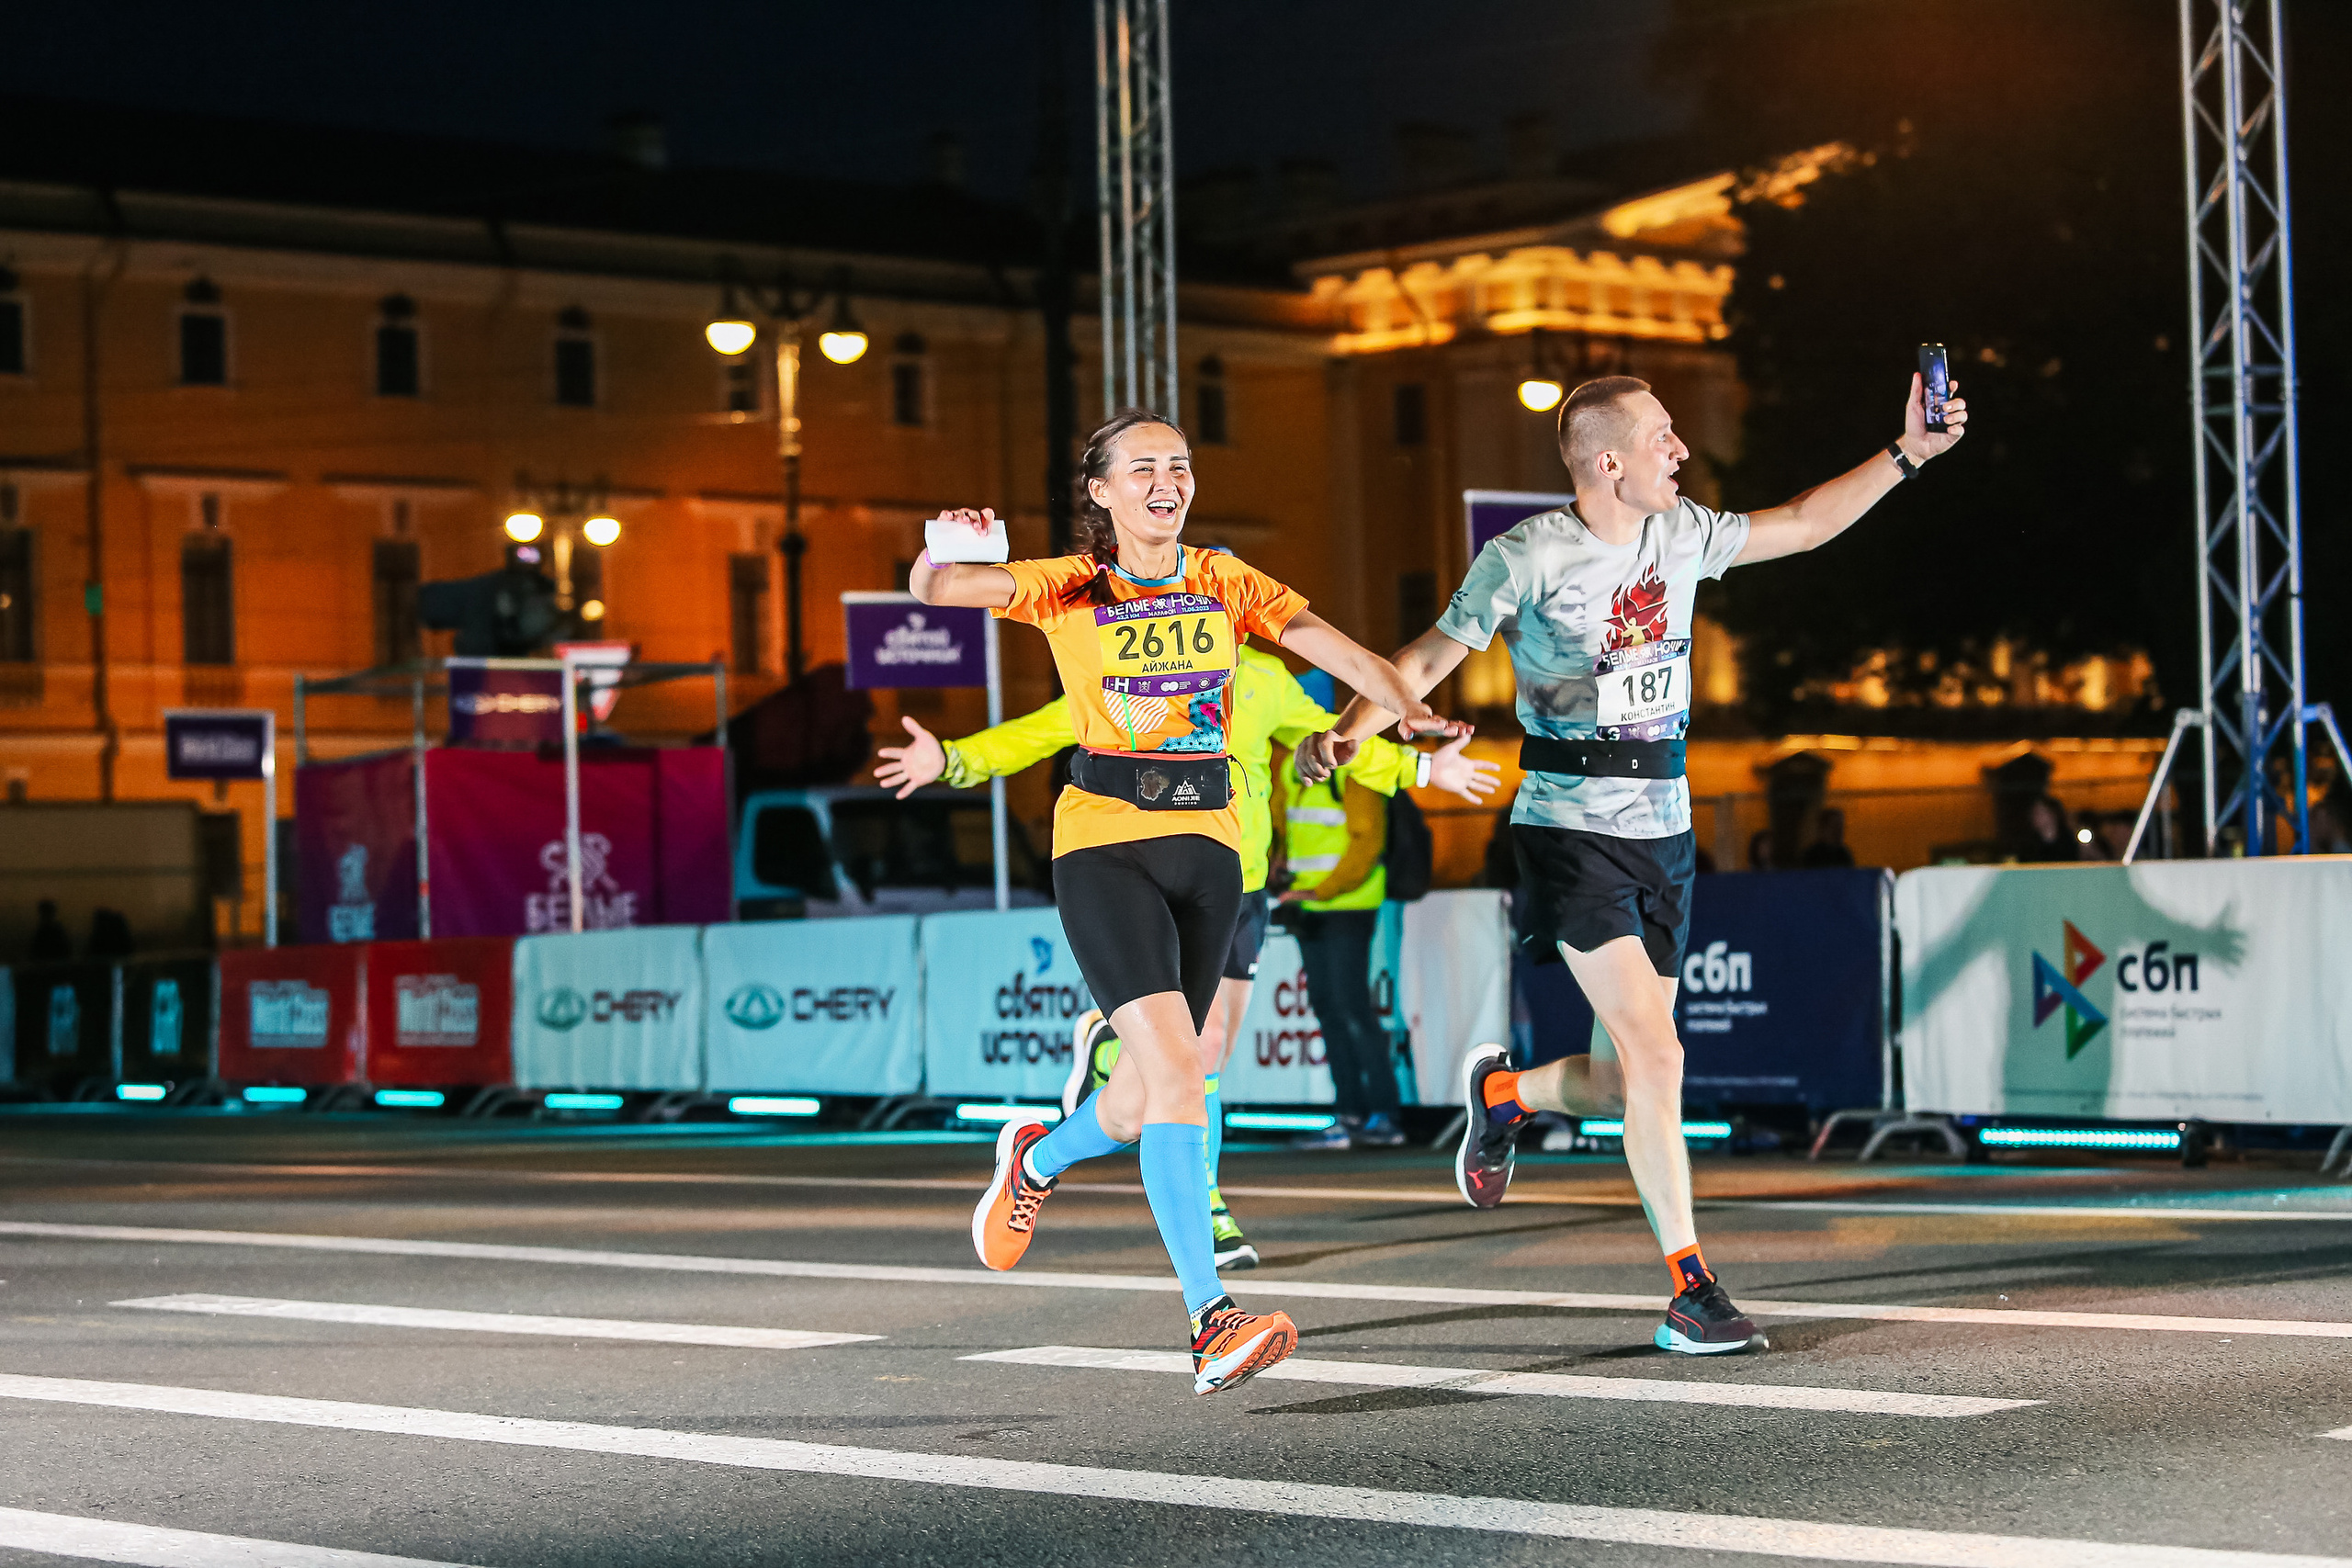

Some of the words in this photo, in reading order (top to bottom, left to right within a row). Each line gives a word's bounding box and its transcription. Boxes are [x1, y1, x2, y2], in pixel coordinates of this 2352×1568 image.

[1107, 599, 1150, 617] БЕЛЫЕ
[1170, 594, 1212, 608] НОЧИ
[1115, 618, 1214, 660] 2616
[1142, 660, 1193, 673] АЙЖАНА
[1623, 666, 1672, 707] 187
[1621, 701, 1676, 722] КОНСТАНТИН
[593, 988, 682, 1022] CHERY
[792, 987, 896, 1021] CHERY
